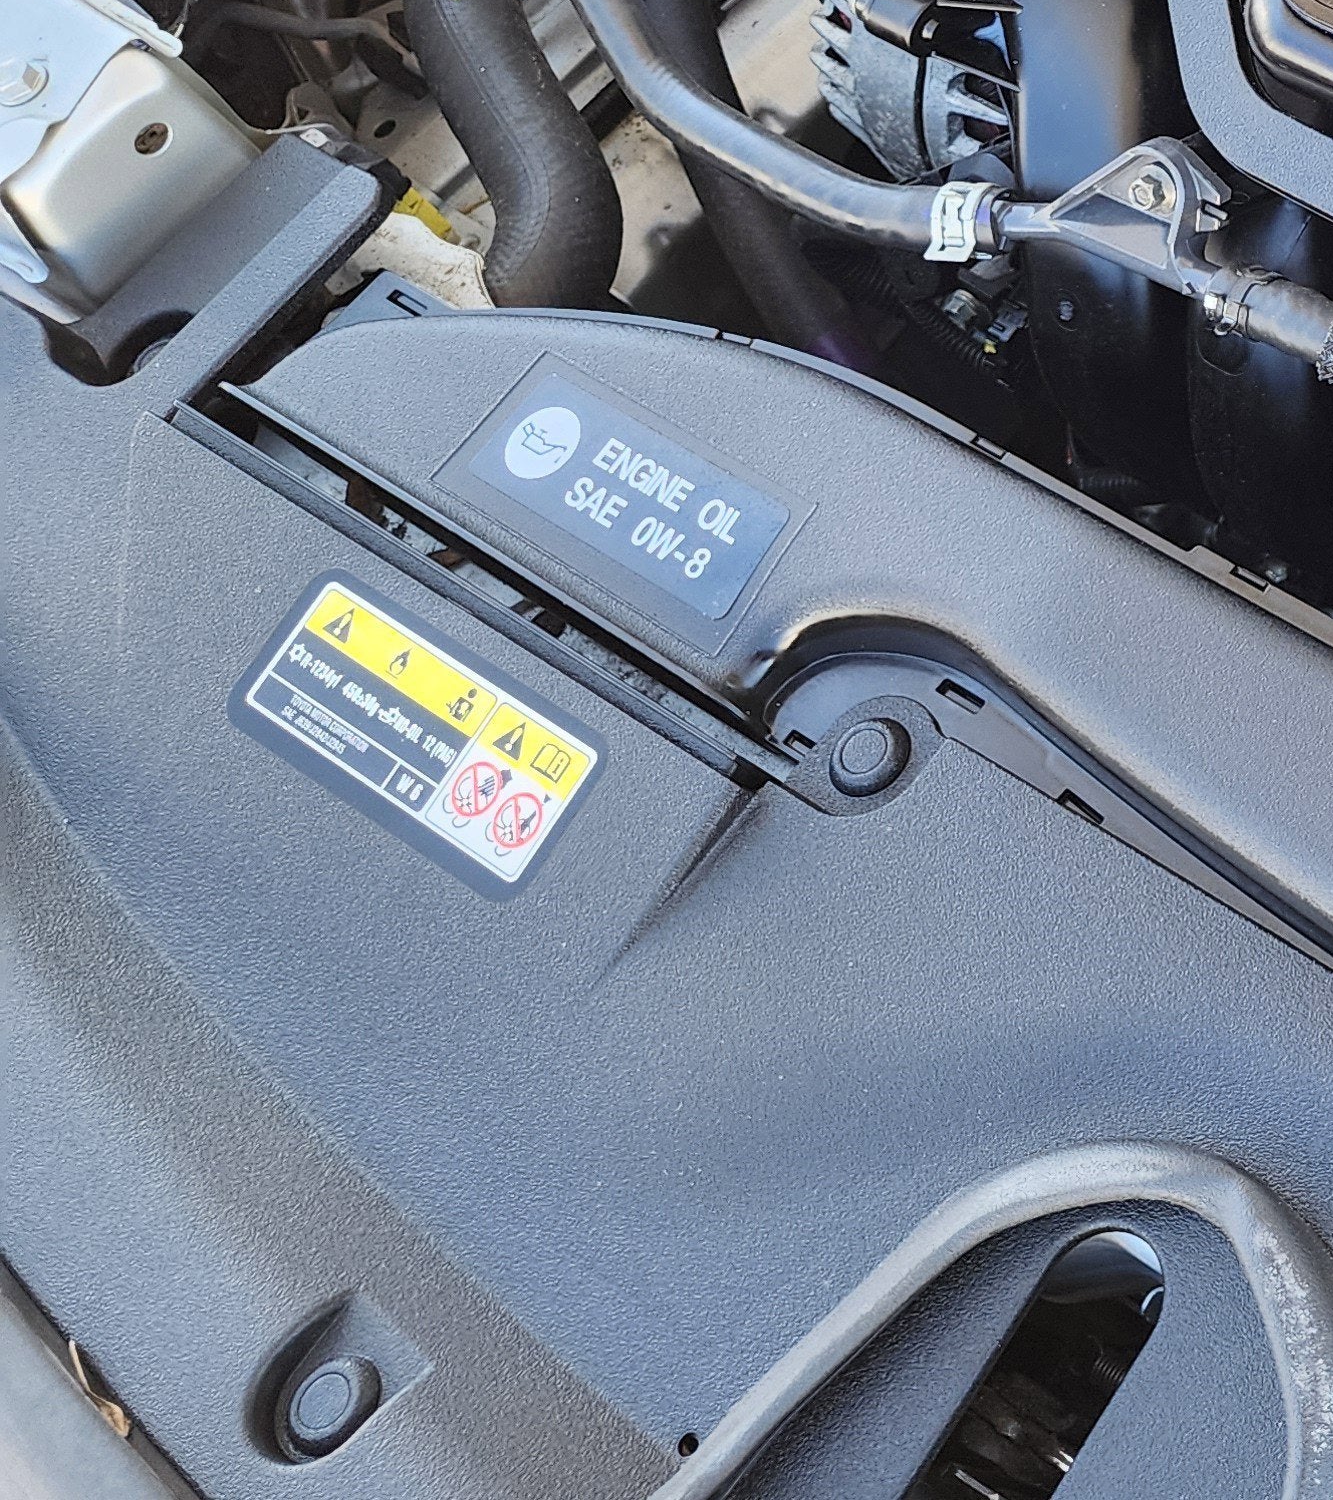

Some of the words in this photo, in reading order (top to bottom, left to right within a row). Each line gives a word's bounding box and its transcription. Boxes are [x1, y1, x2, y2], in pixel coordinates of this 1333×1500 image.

[560, 472, 630, 532] SAE
[626, 511, 716, 583] 0W-8
[589, 434, 697, 515] ENGINE
[693, 493, 749, 546] OIL
[394, 772, 416, 795] W
[408, 782, 424, 802] 6
